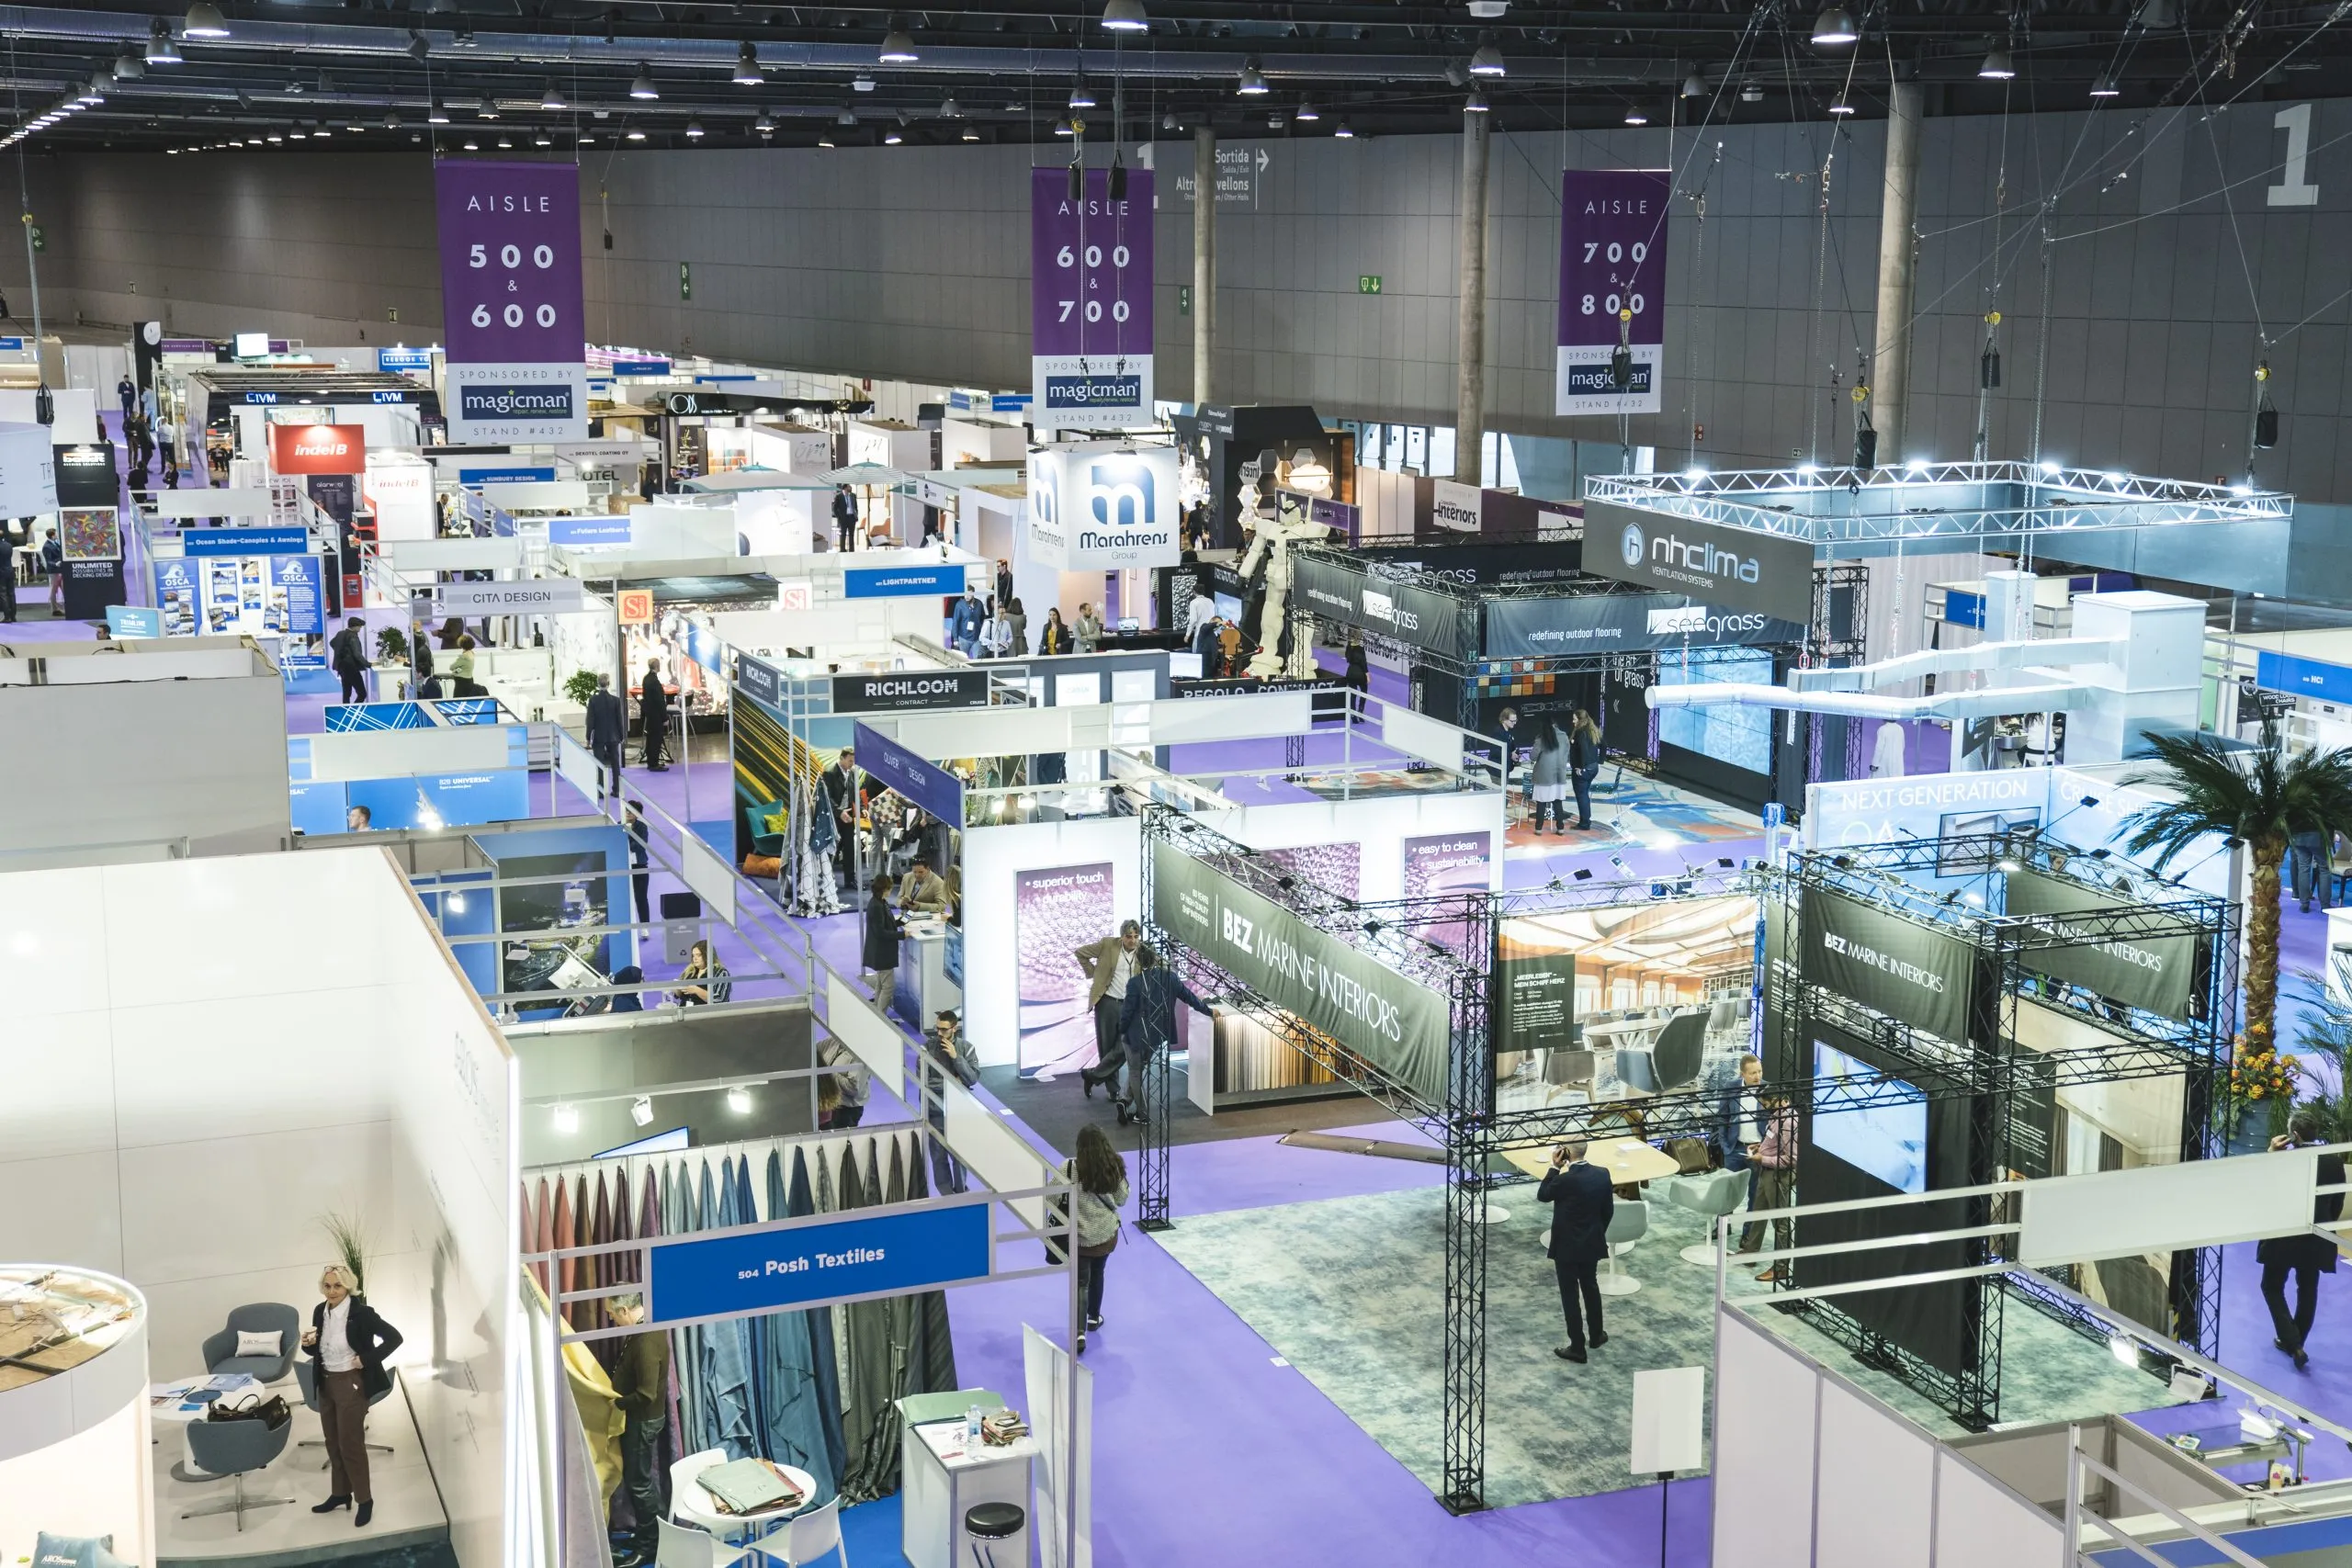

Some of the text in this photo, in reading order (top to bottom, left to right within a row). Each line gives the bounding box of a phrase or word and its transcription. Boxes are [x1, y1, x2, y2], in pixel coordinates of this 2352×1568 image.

[1215, 149, 1250, 164] Sortida
[2267, 103, 2320, 207] 1
[1176, 176, 1250, 191] Altr vellons
[468, 196, 551, 212] AISLE
[1057, 200, 1129, 216] AISLE
[1585, 200, 1647, 215] AISLE
[469, 244, 555, 269] 500
[1057, 245, 1130, 268] 600
[1583, 243, 1647, 264] 700
[507, 279, 519, 292] &
[1089, 277, 1099, 289] &
[1610, 273, 1619, 283] &
[1057, 300, 1130, 322] 700
[1581, 294, 1645, 315] 800
[471, 304, 557, 329] 600
[1569, 352, 1634, 360] SPONSOD
[459, 370, 573, 379] SPONSORED BY
[1046, 362, 1121, 370] SPONORE
[1572, 368, 1647, 389] magican
[1050, 379, 1136, 401] magicman
[466, 389, 568, 413] magicman
[473, 428, 519, 436] STAND
[582, 469, 620, 481] OTEL
[1438, 502, 1477, 525] Interiors
[1032, 524, 1065, 548] Marahrens
[1080, 530, 1168, 549] Marahrens
[1111, 550, 1137, 561] Group
[1652, 534, 1759, 583] nhclima
[883, 577, 936, 585] LIGHTPARTNER
[1556, 569, 1580, 579] flooring
[1652, 566, 1713, 589] VENTILATION SYSTEMS
[473, 591, 551, 604] CITA DESIGN
[1529, 626, 1622, 641] redefining outdoor flooring
[746, 663, 772, 690] RICHLOOM
[1624, 670, 1645, 689] grass
[865, 679, 958, 697] RICHLOOM
[452, 777, 491, 785] UNIVERSAL
[909, 767, 926, 786] DESIGN
[1842, 779, 2028, 811] NEXT GENERATION
[1419, 840, 1478, 856] easy to clean
[1426, 855, 1485, 871] sustainability
[1032, 872, 1104, 890] superior touch
[1042, 889, 1087, 903] durability
[1825, 931, 1943, 994] BEZ MARINE INTERIORS
[2104, 941, 2163, 973] INTERIORS
[1223, 908, 1401, 1042] BEZ MARINE INTERIORS
[738, 1247, 886, 1280] 504 Posh Textiles
